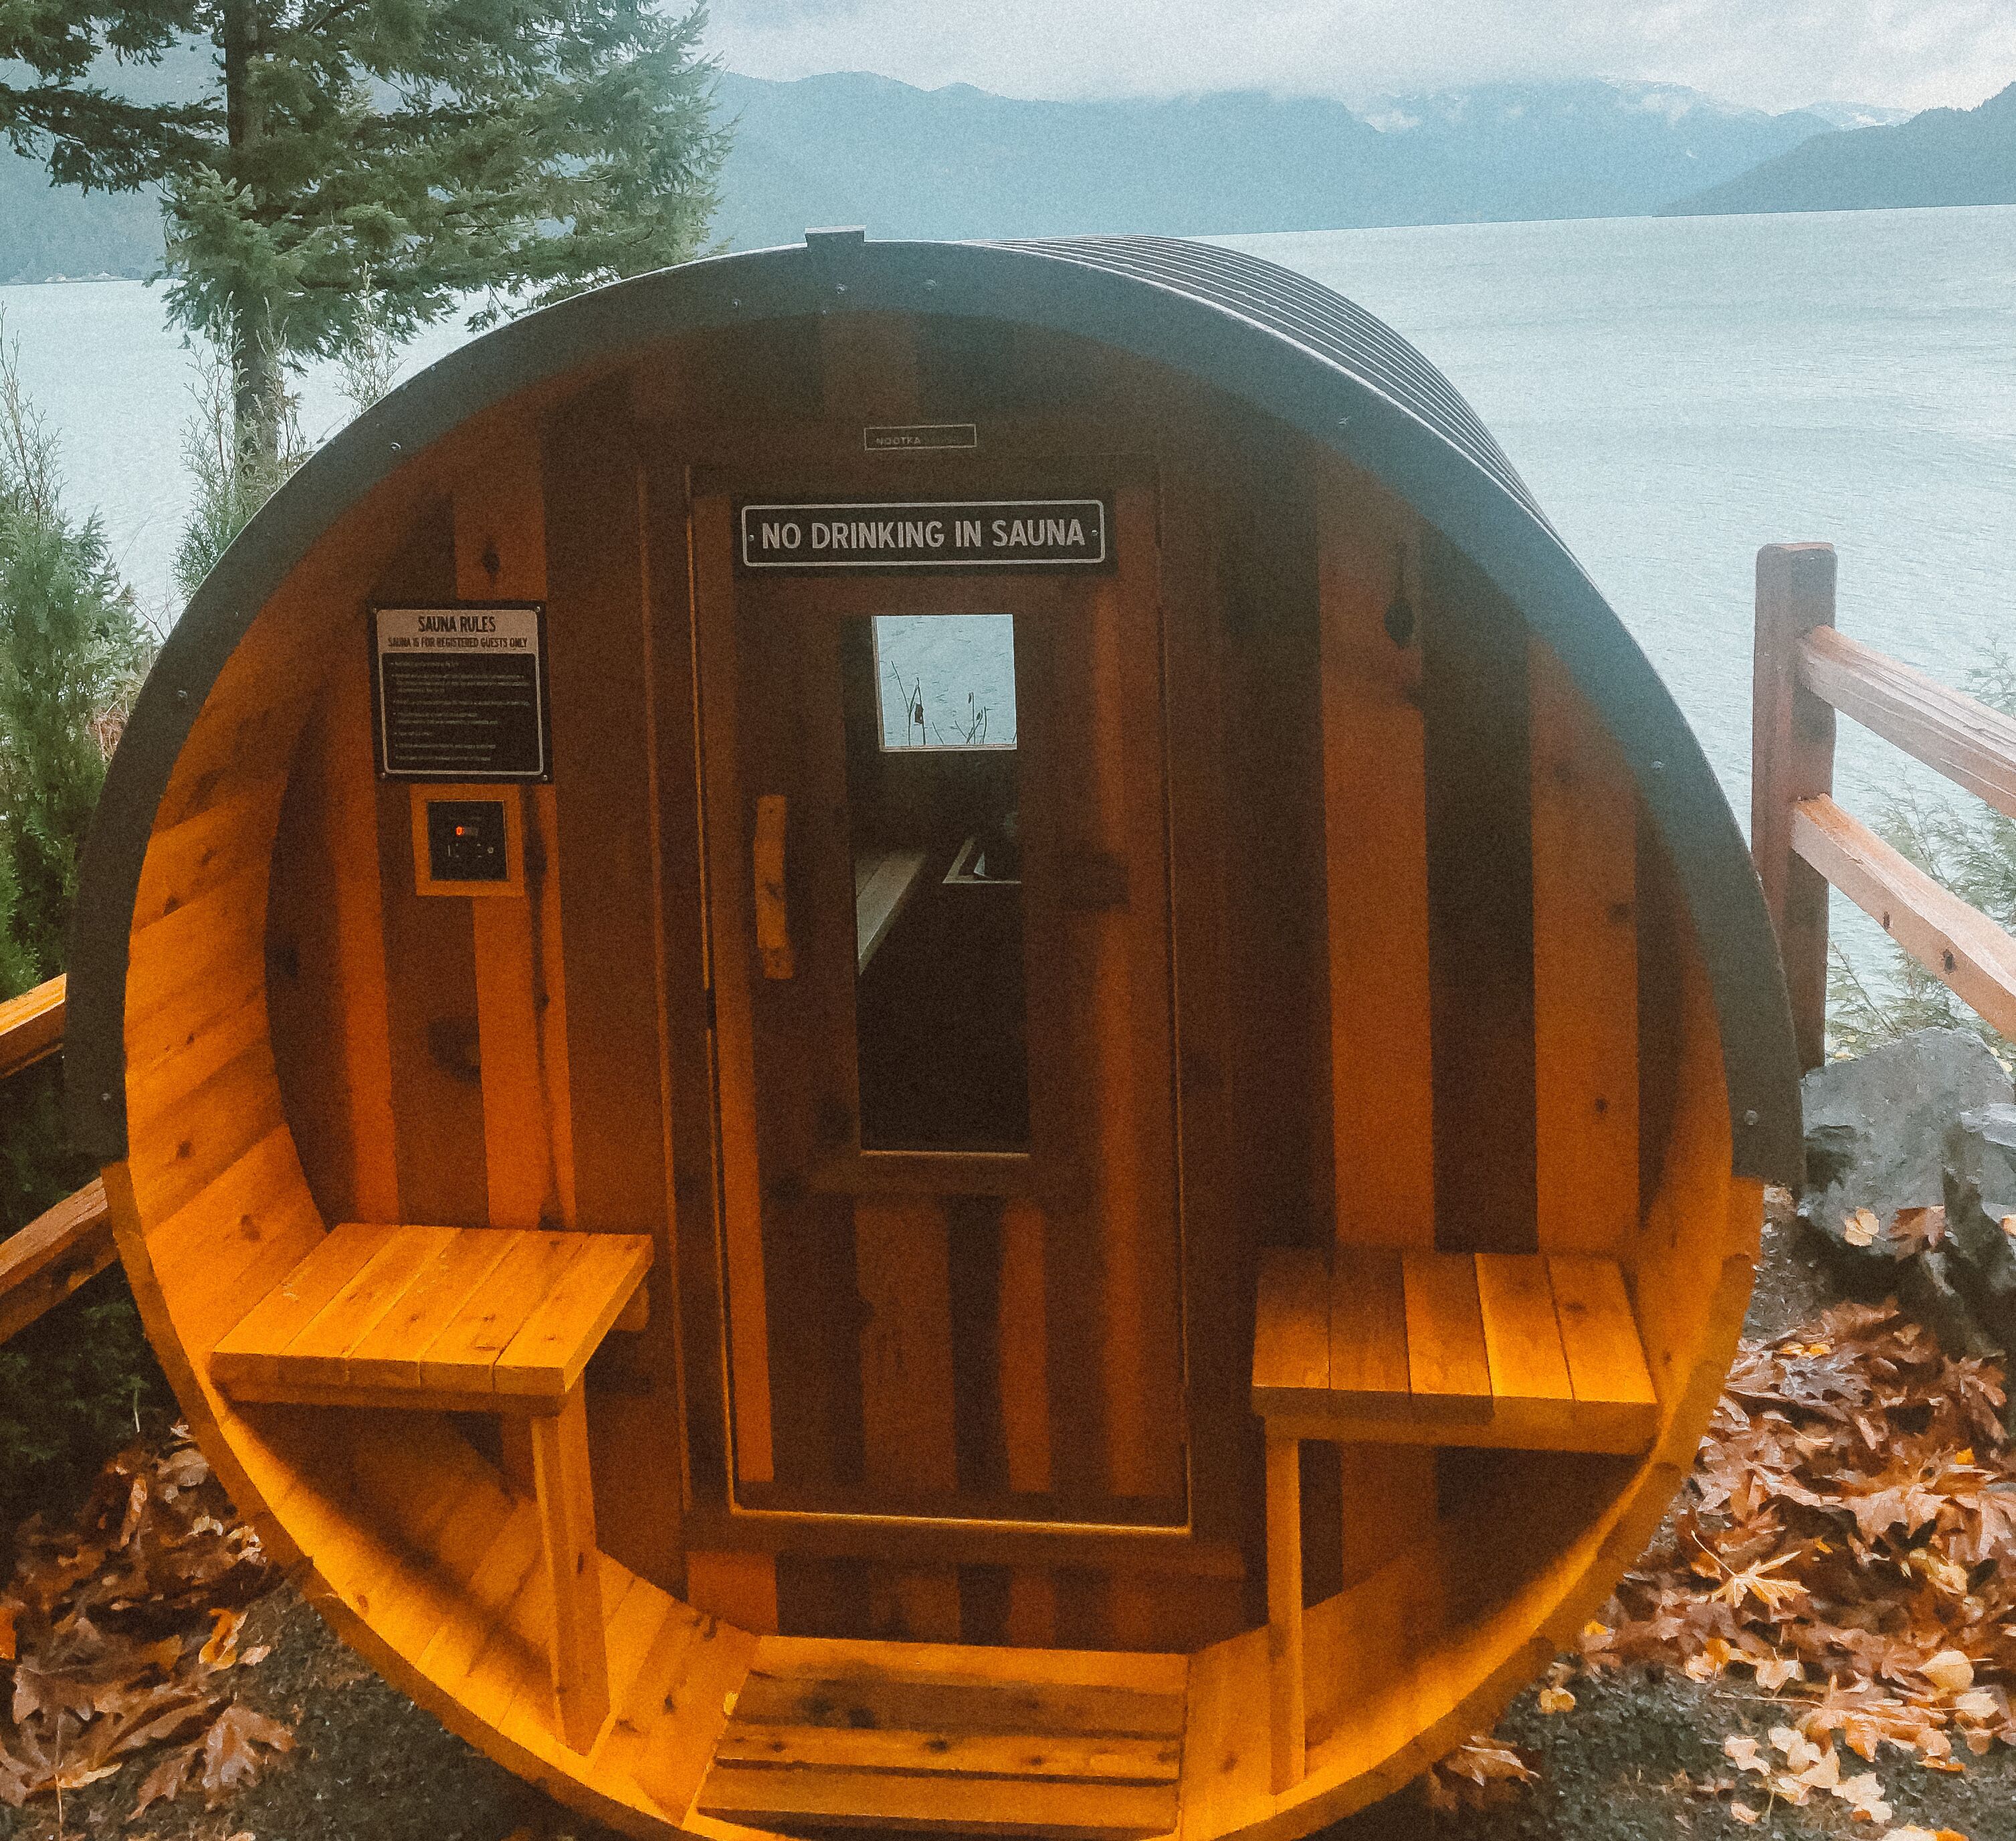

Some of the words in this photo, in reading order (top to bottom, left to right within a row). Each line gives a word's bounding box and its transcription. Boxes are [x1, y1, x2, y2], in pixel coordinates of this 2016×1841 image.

[876, 437, 921, 446] NOOTKA
[762, 522, 801, 549] NO
[811, 520, 944, 549] DRINKING
[955, 520, 981, 547] IN
[992, 518, 1085, 547] SAUNA
[418, 615, 457, 632] SAUNA
[460, 615, 496, 632] RULES
[388, 637, 411, 648] SAUNA
[413, 637, 419, 647] IS
[421, 636, 435, 648] FOR
[436, 637, 478, 648] REGISTERED
[480, 637, 508, 648] GUESTS
[510, 637, 527, 648] ONLY
